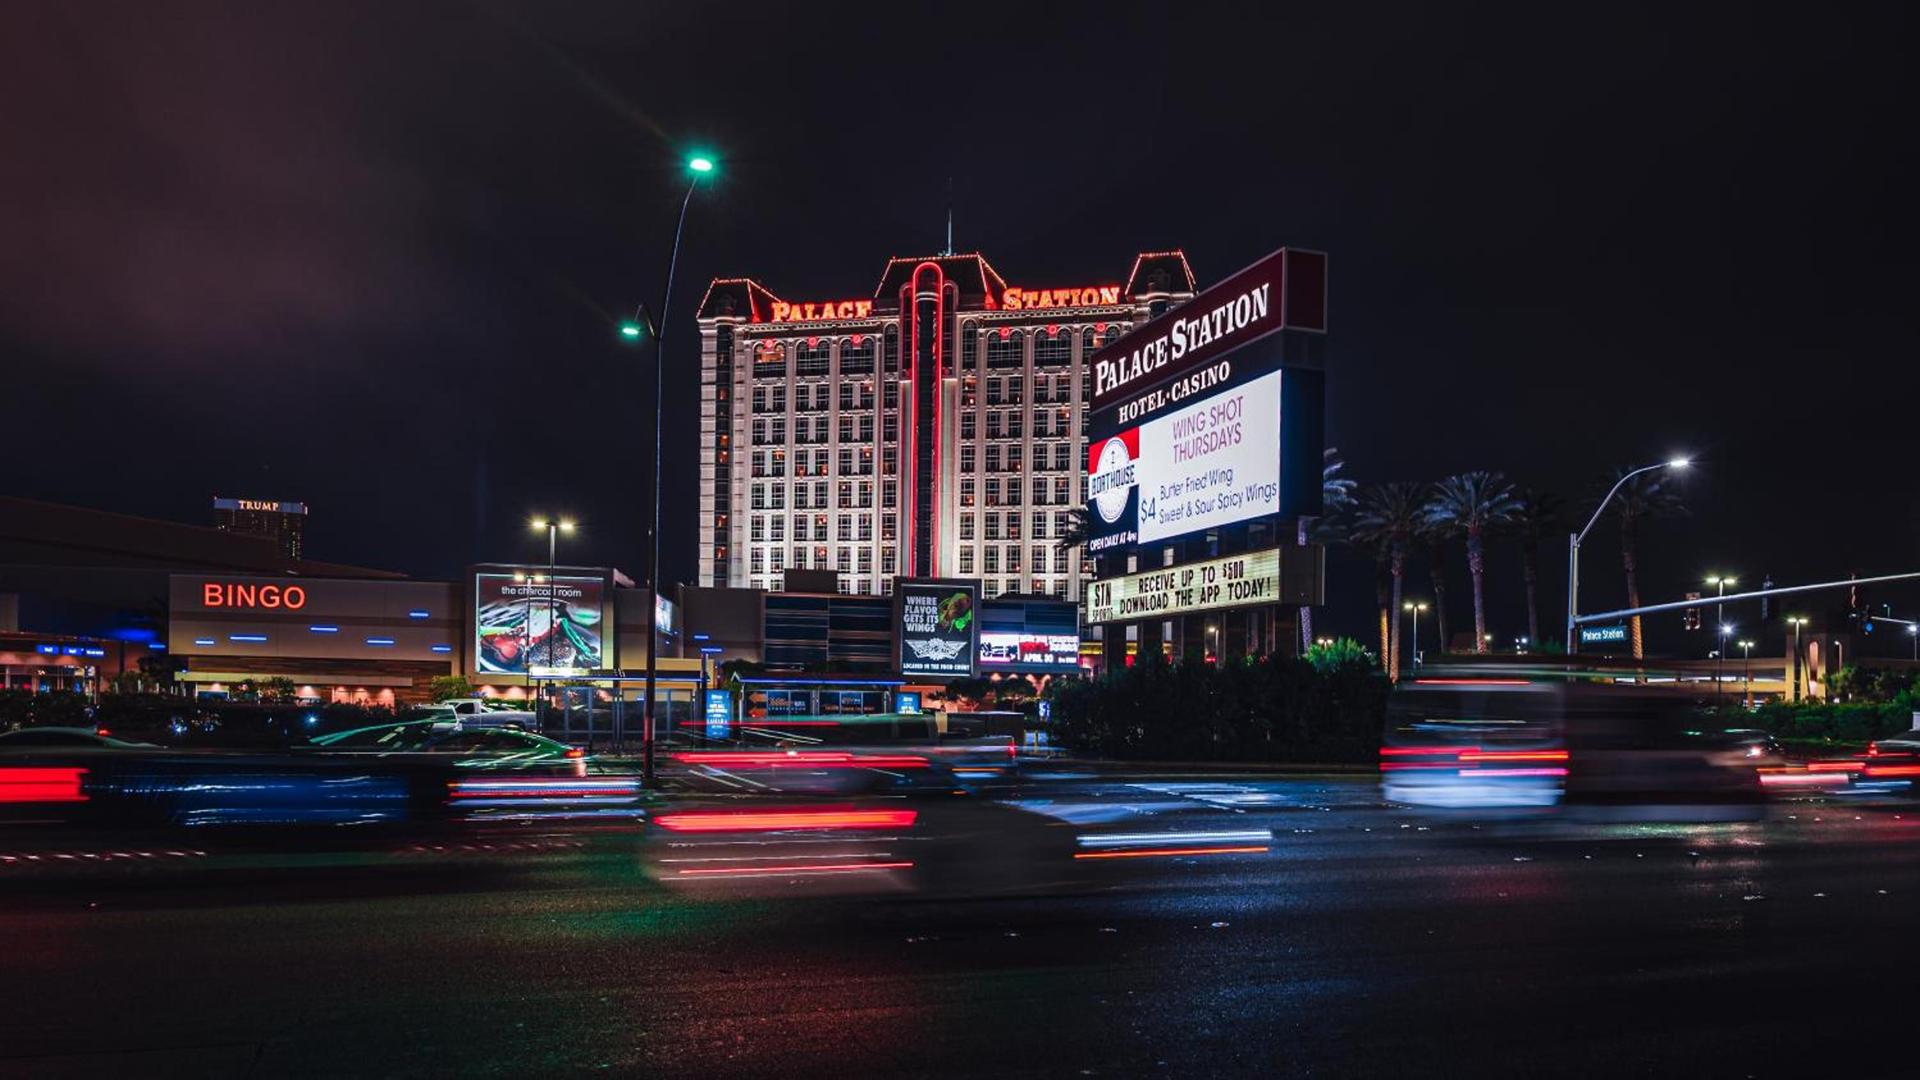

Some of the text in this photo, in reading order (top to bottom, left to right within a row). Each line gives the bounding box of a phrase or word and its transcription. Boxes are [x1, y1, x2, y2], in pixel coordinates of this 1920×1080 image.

[771, 286, 1121, 323] PALACE STATION
[1095, 283, 1270, 396] PALACE STATION
[1173, 396, 1243, 441] WING SHOT
[1173, 422, 1242, 464] THURSDAYS
[1209, 468, 1233, 486] Wing
[238, 500, 279, 511] TRUMP
[1140, 496, 1156, 524] $4
[1159, 482, 1277, 524] Sweet & Sour Spicy Wings
[1090, 538, 1104, 551] OPEN
[1104, 533, 1120, 548] DAILY
[1119, 531, 1127, 544] AT
[1138, 560, 1244, 594] RECEIVE UP TO $500
[203, 583, 306, 609] BINGO
[501, 586, 516, 595] the
[558, 588, 582, 597] room
[906, 596, 938, 605] WHERE
[1094, 582, 1112, 607] STN
[1120, 576, 1271, 615] DOWNLOAD THE APP TODAY!
[903, 614, 939, 623] GETS ITS
[904, 605, 938, 614] FLAVOR
[905, 623, 936, 632] WINGS
[1582, 631, 1601, 640] Palace
